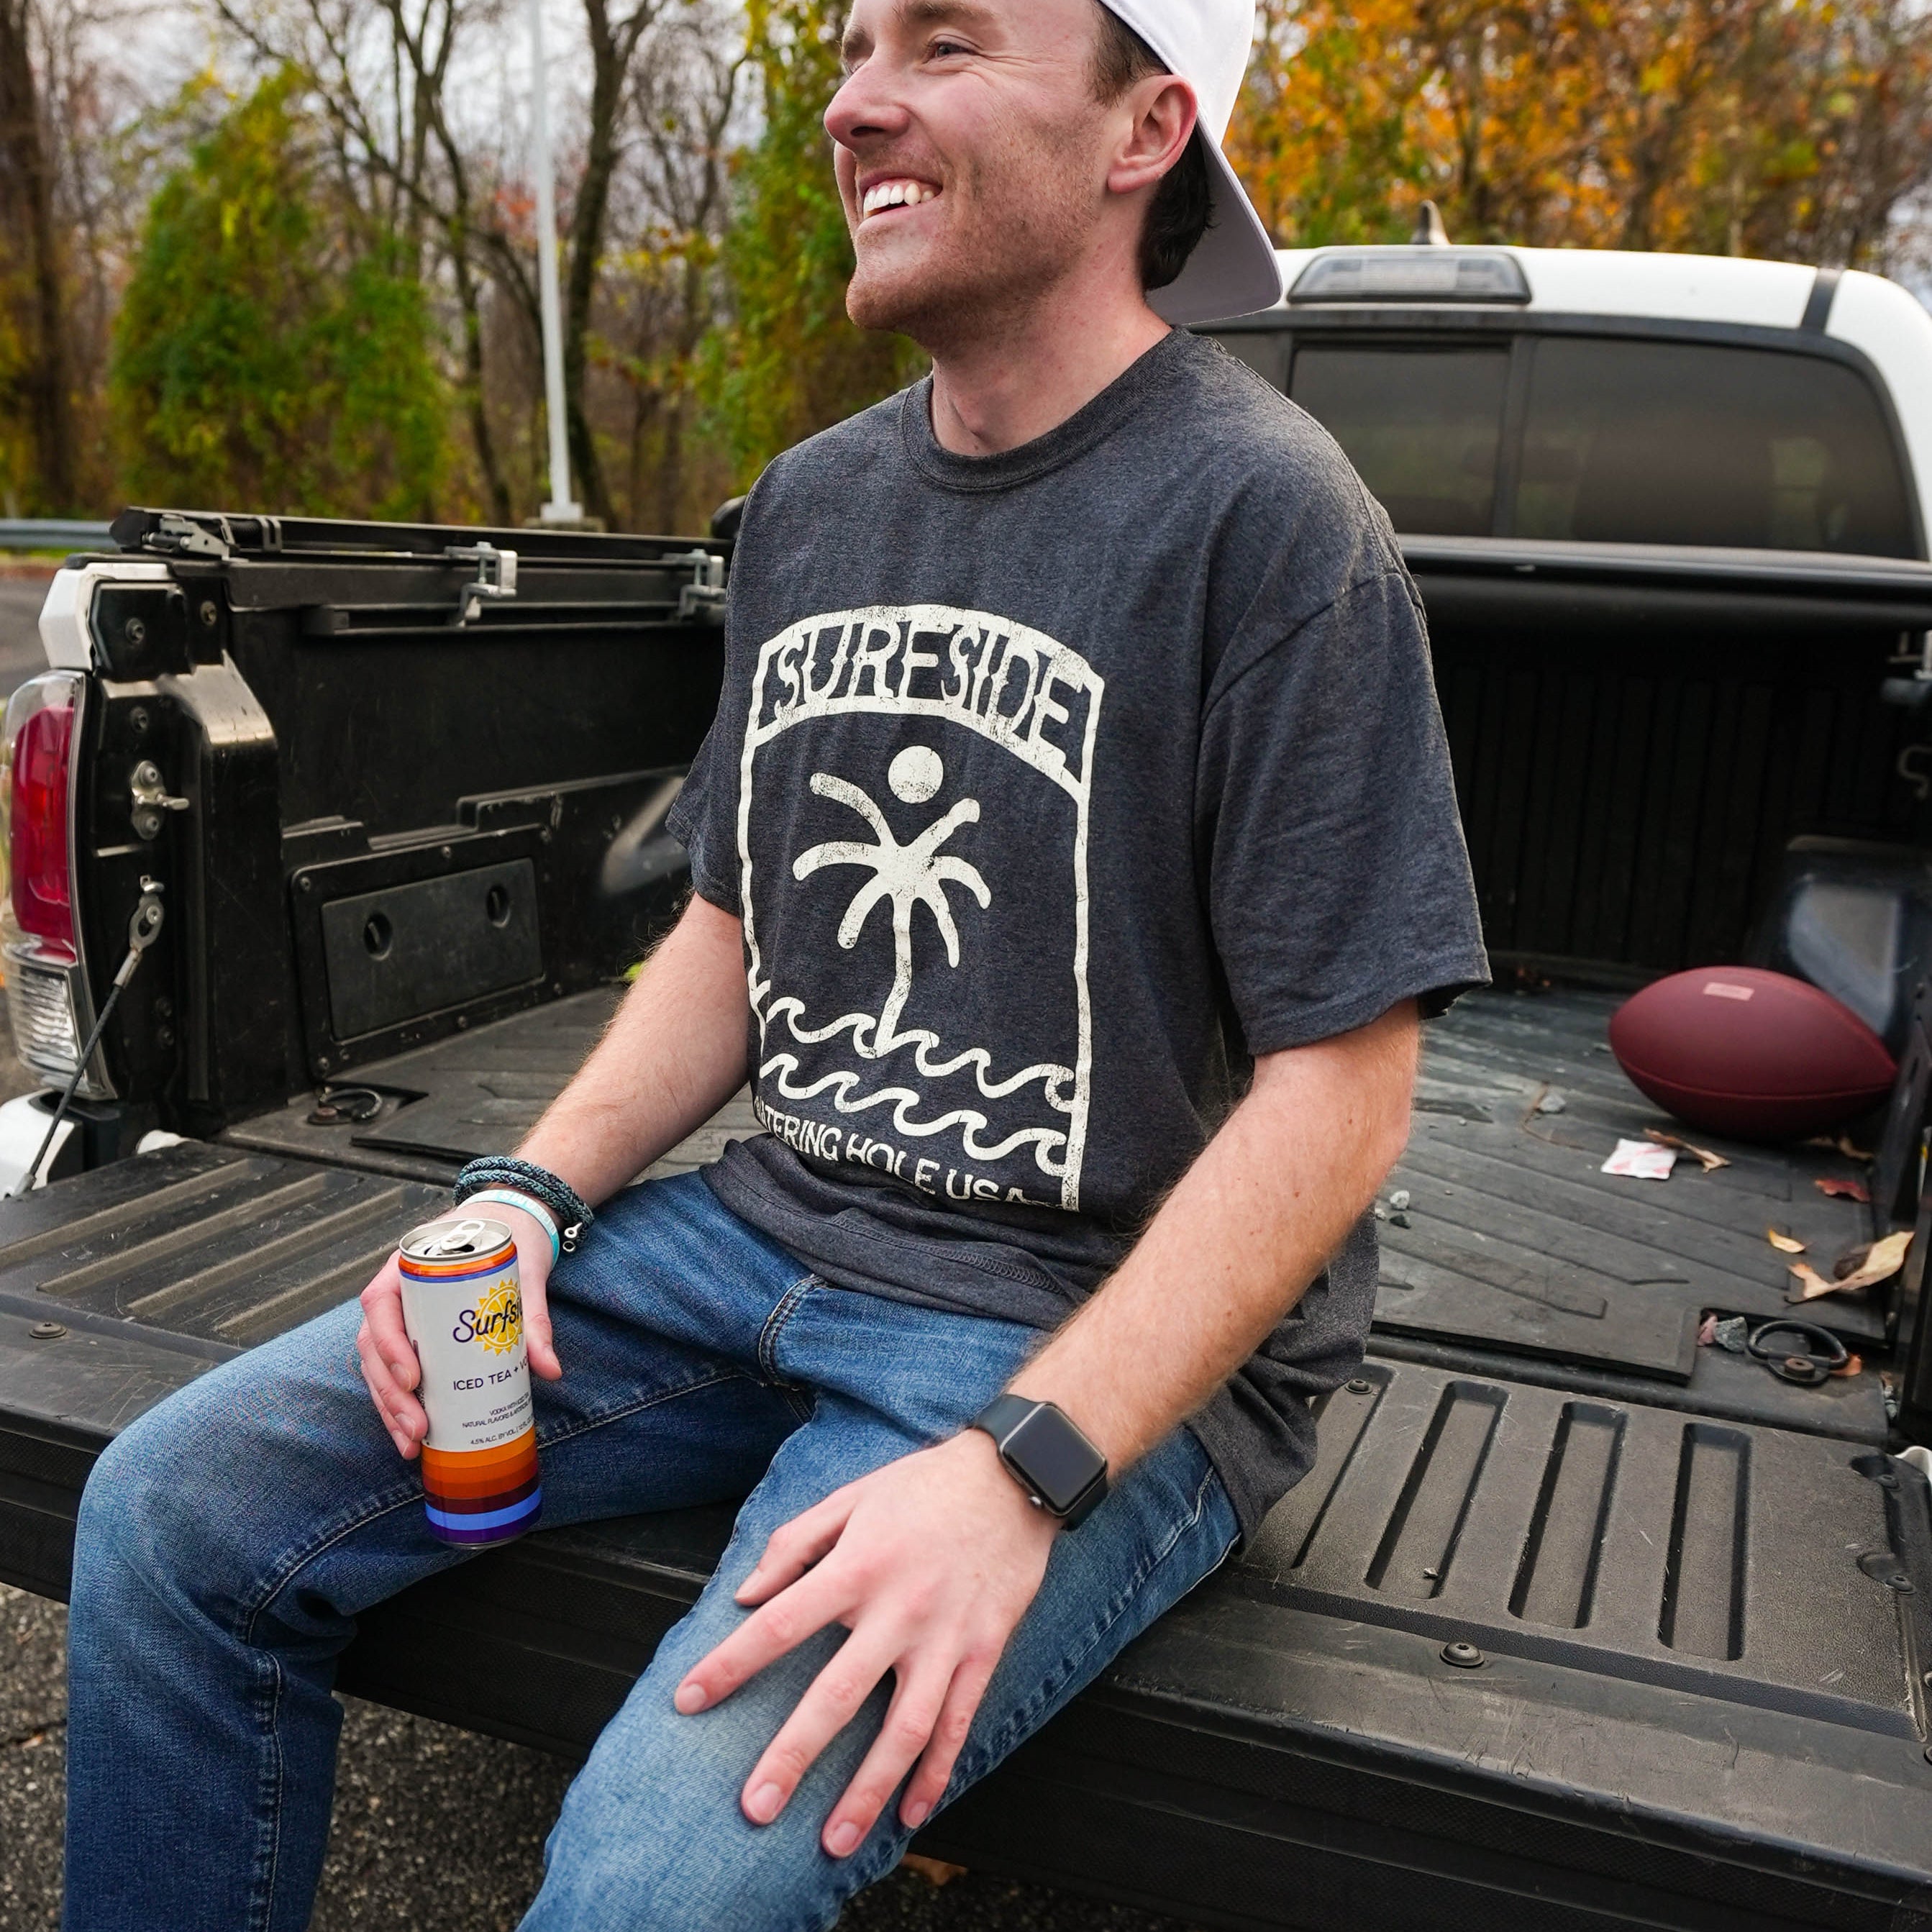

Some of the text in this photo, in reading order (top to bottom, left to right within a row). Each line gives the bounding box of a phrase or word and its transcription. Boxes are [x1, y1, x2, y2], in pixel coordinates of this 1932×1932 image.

[774, 603, 1085, 767] SURFSIDE
[846, 1133, 940, 1195] HOLE
[453, 1377, 484, 1390] ICED
[488, 1369, 512, 1385] TEA
[463, 1420, 487, 1429] NATURAL
[488, 1412, 509, 1424] FLAVORS
[489, 1406, 507, 1416] VODKA
